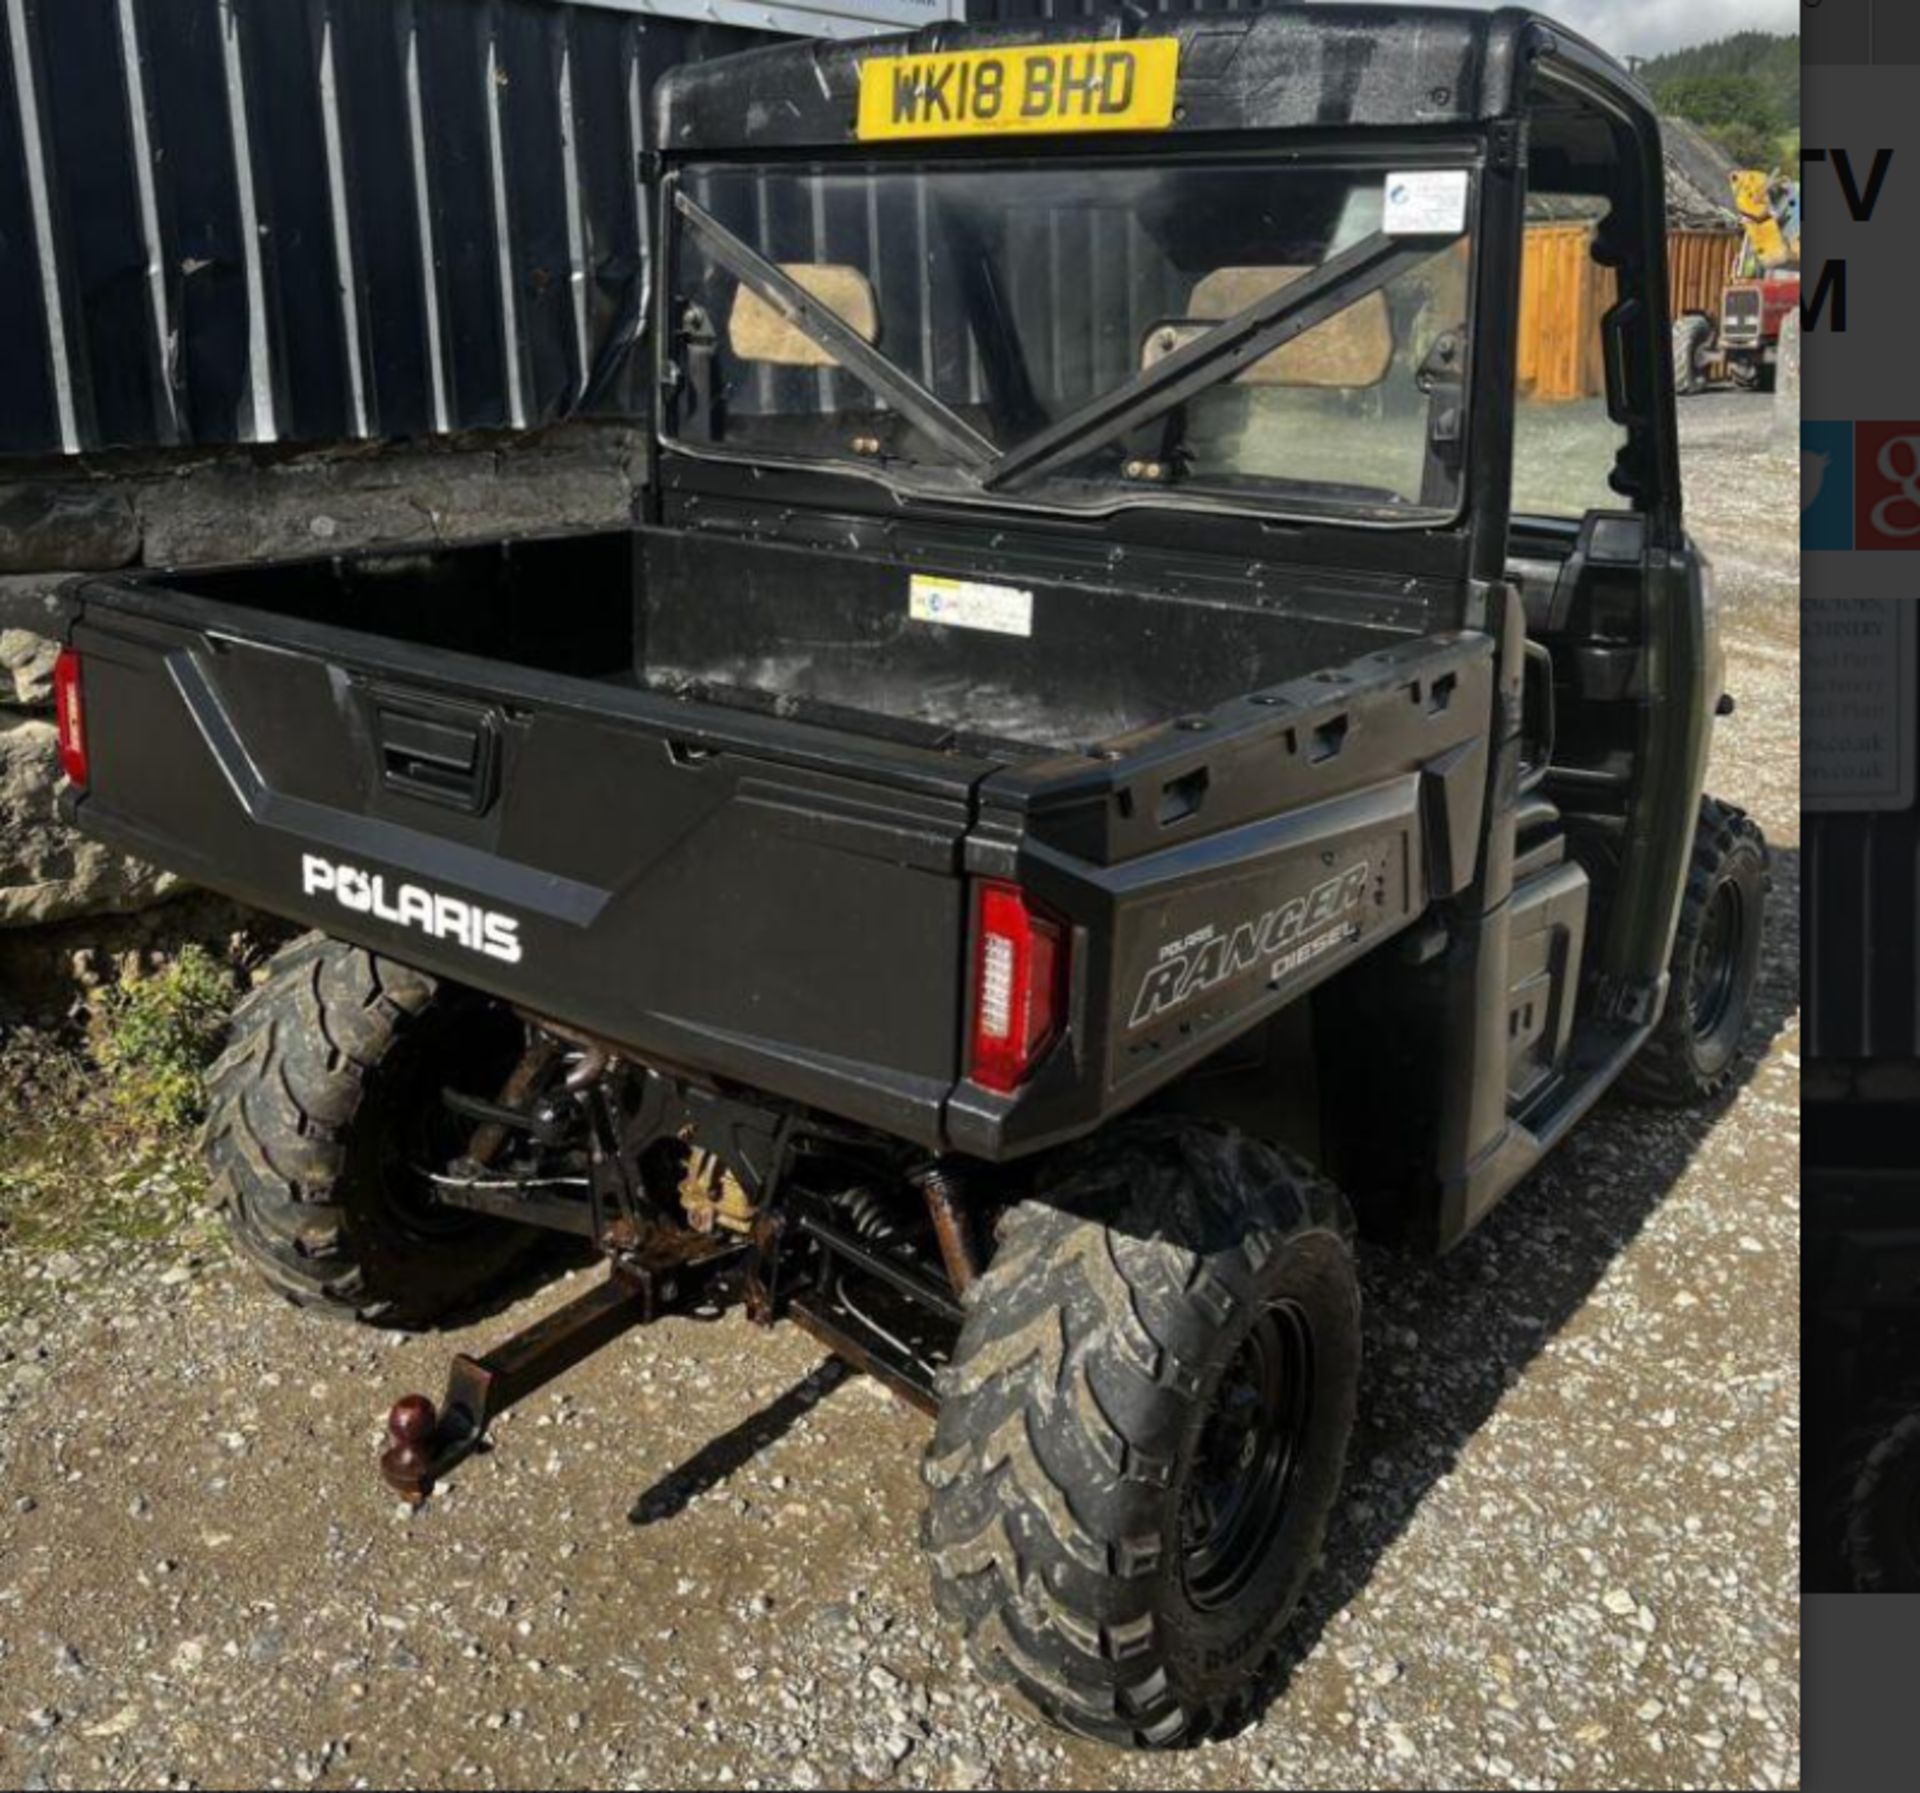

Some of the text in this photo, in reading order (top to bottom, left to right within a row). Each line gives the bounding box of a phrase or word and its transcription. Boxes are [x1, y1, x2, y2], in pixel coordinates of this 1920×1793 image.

[891, 50, 1137, 125] WK18 BHD
[302, 853, 522, 964] POLARIS
[1127, 860, 1369, 1029] RANGER
[1270, 921, 1359, 980] DIESEL
